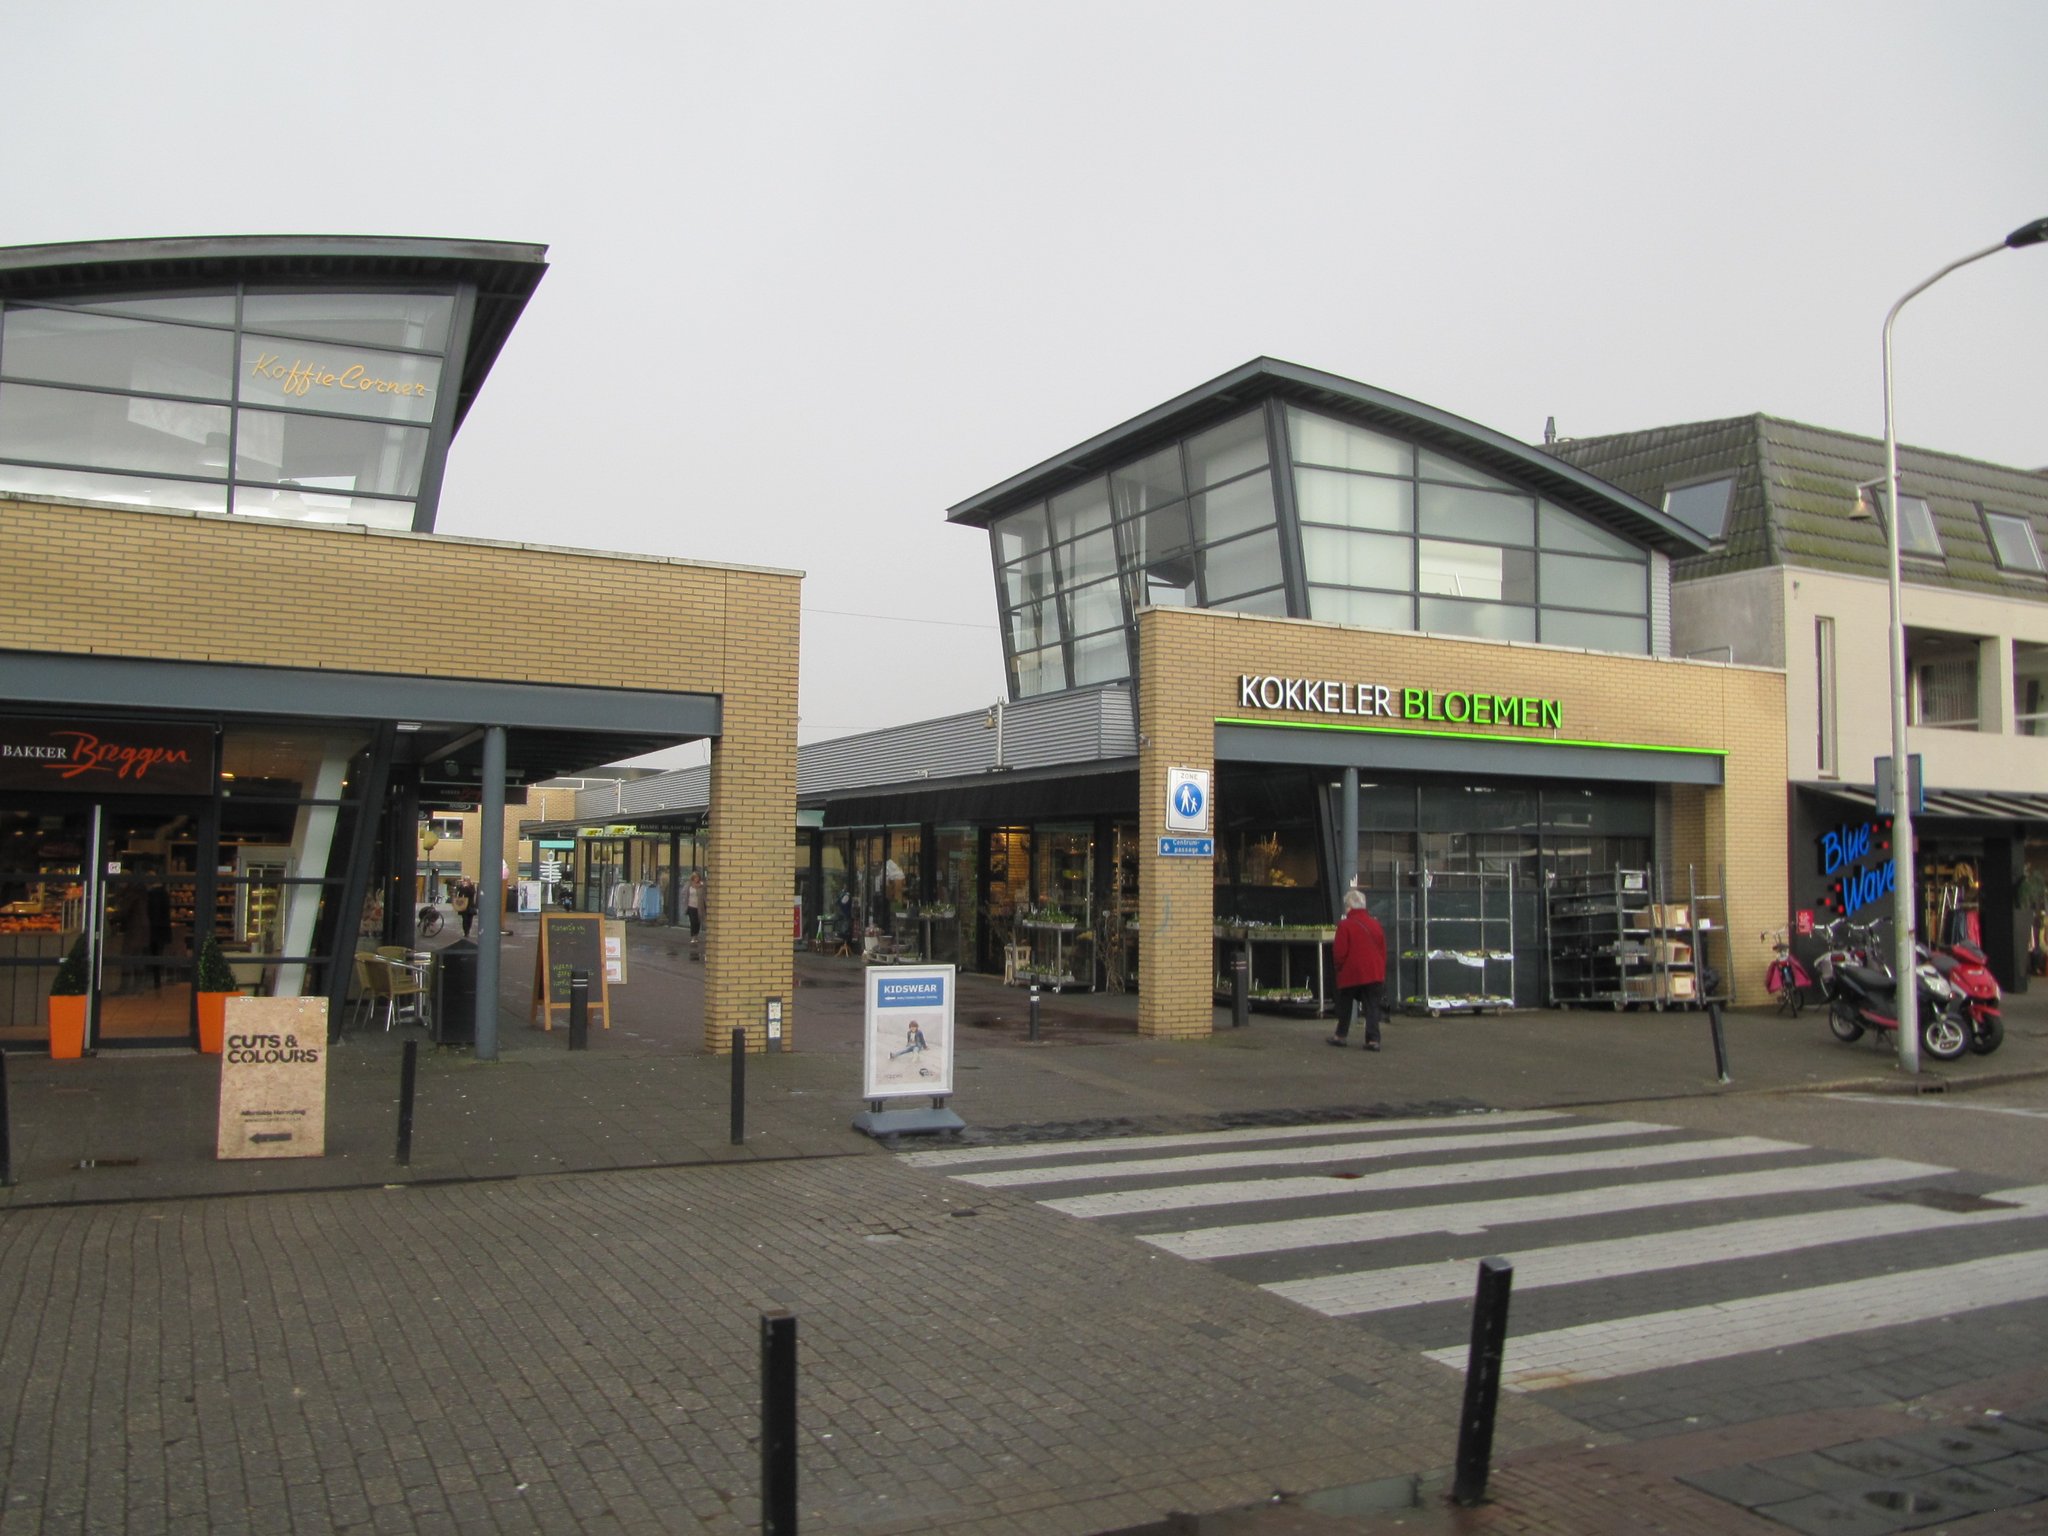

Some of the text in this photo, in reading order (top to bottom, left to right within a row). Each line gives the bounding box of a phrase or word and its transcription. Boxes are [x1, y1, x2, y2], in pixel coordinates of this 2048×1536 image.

[1239, 673, 1564, 730] KOKKELER BLOEMEN
[3, 730, 192, 779] BAKKER Breggen
[1821, 822, 1871, 875] Blue
[1842, 858, 1896, 917] Wave
[884, 984, 937, 994] KIDSWEAR
[227, 1049, 319, 1064] COLOURS
[228, 1034, 298, 1049] CUTS &
